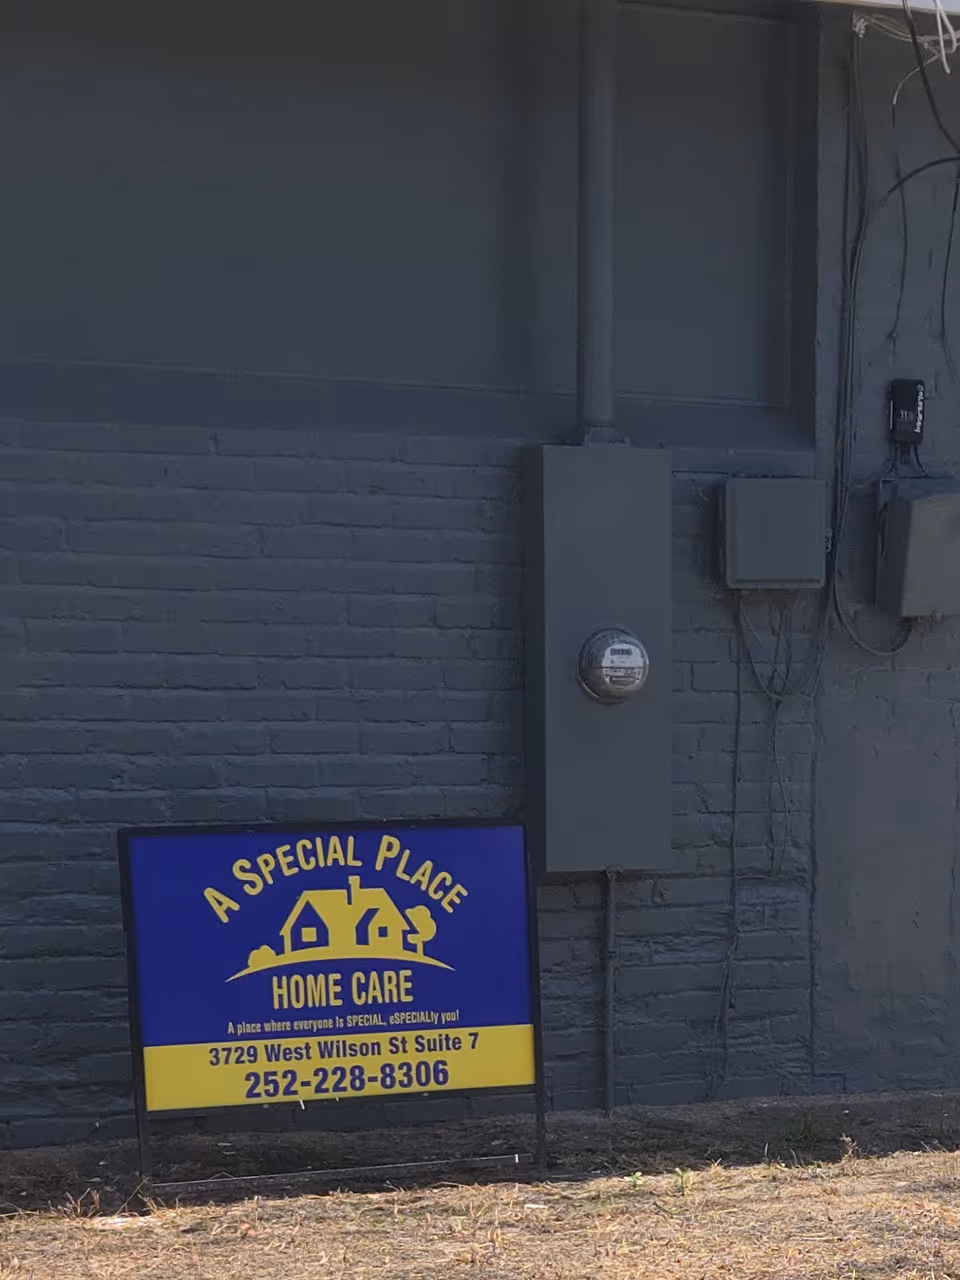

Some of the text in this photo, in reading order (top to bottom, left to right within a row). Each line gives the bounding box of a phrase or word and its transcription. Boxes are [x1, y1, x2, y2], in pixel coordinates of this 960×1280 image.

[203, 834, 469, 924] A SPECIAL PLACE
[272, 969, 414, 1010] HOME CARE
[227, 1021, 236, 1034] A
[237, 1020, 262, 1037] place
[263, 1018, 291, 1032] where
[293, 1018, 334, 1033] everyone
[346, 1013, 388, 1028] SPECIAL,
[389, 1010, 439, 1025] eSPECIALly
[440, 1008, 460, 1025] you!
[208, 1032, 480, 1067] 3729 West Wilson St Suite 7
[244, 1060, 450, 1100] 252-228-8306
